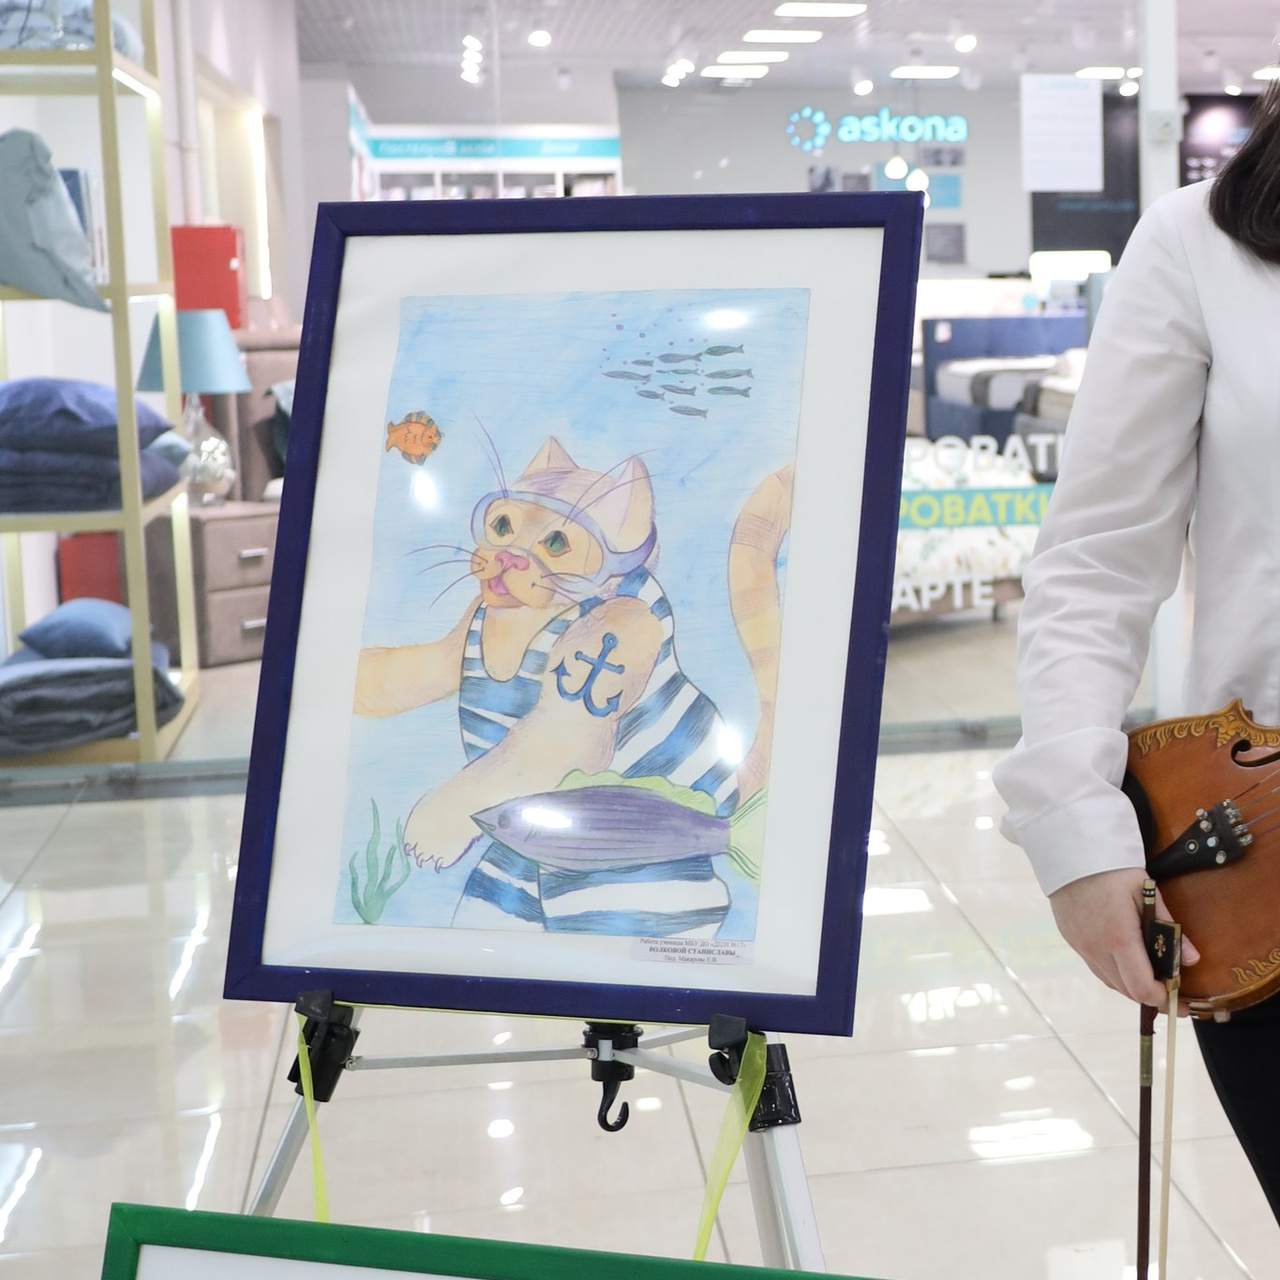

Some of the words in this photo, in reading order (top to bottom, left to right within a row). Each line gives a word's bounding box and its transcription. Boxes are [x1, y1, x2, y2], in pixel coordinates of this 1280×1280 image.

[837, 106, 968, 142] askona
[905, 433, 1065, 475] РОВАТ
[649, 946, 687, 954] ВОЛКОВОЙ
